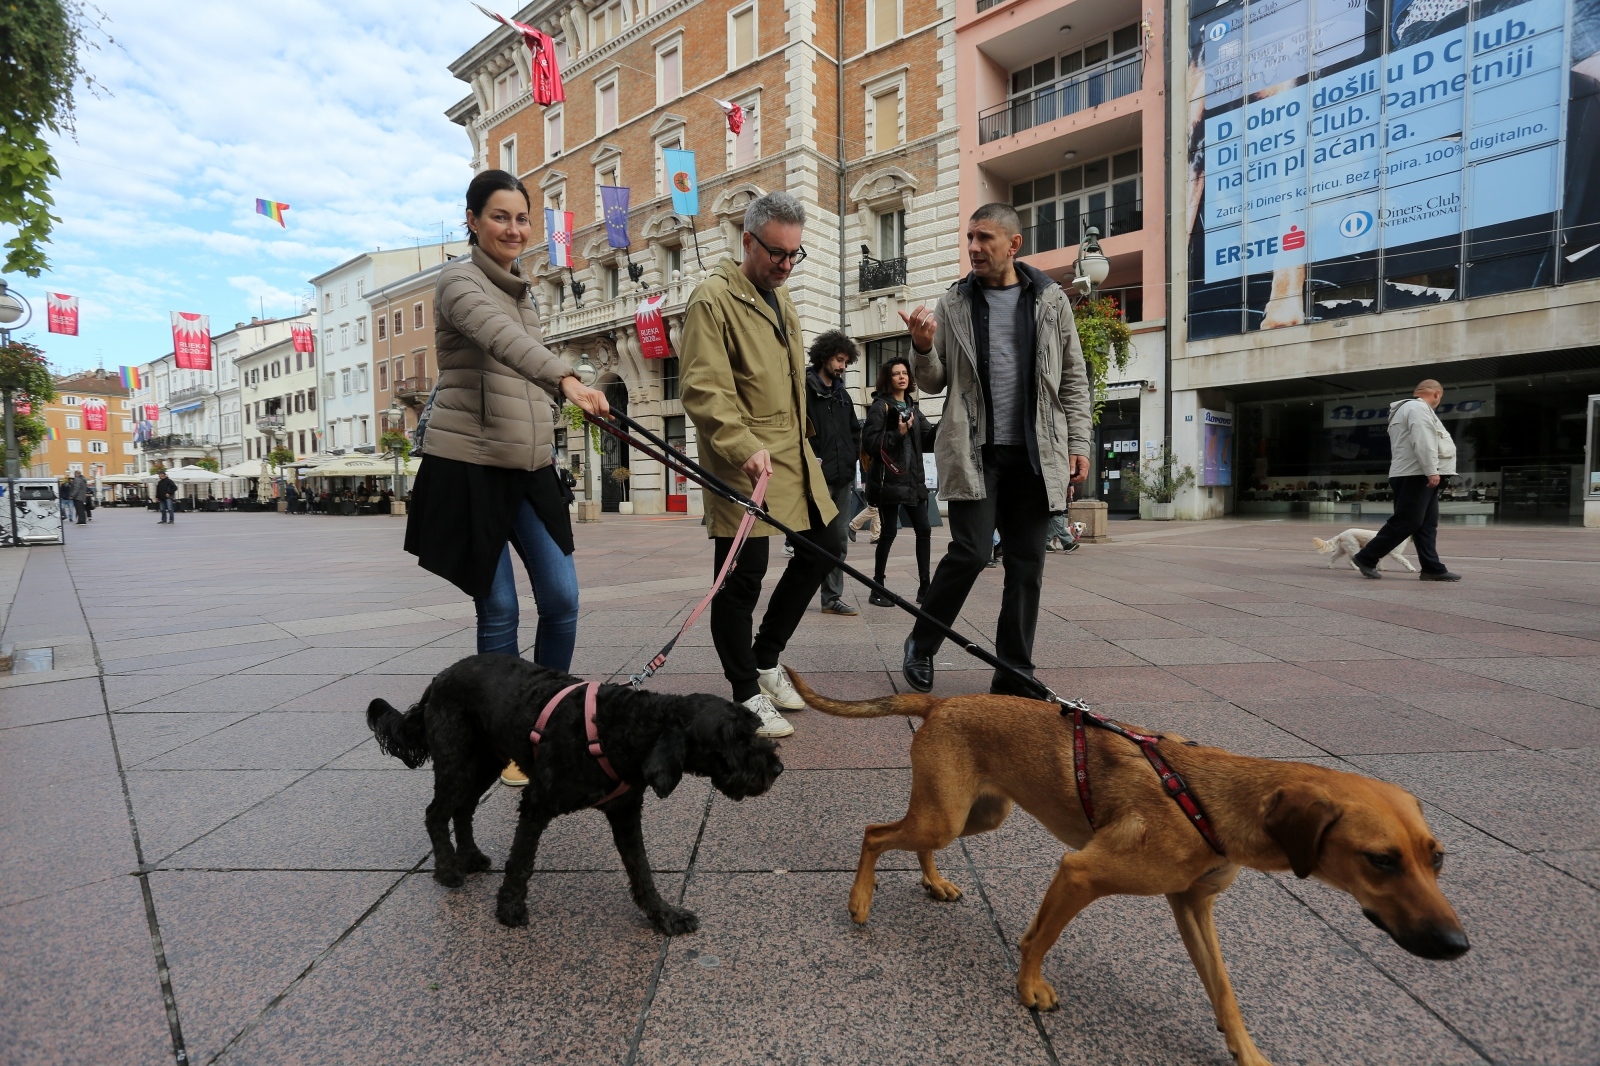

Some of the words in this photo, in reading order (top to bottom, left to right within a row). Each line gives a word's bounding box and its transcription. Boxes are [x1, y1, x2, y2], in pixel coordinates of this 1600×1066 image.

[1313, 70, 1374, 109] došli
[1387, 64, 1403, 83] u
[1218, 129, 1295, 166] Diners
[1312, 106, 1370, 137] Club.
[1386, 45, 1533, 109] Pametniji
[1216, 201, 1253, 218] Zatraži
[1256, 190, 1293, 208] Diners
[1296, 179, 1342, 198] karticu.
[1346, 170, 1370, 185] Bez
[1374, 158, 1421, 184] papira.
[1425, 144, 1465, 164] 100%
[1469, 123, 1548, 150] digitalno.
[1218, 160, 1276, 192] način
[1378, 203, 1422, 220] Diners
[1426, 192, 1460, 209] Club
[1380, 206, 1461, 228] INTERNATIONAL
[1215, 236, 1279, 266] ERSTE
[179, 341, 207, 350] RIJEKA
